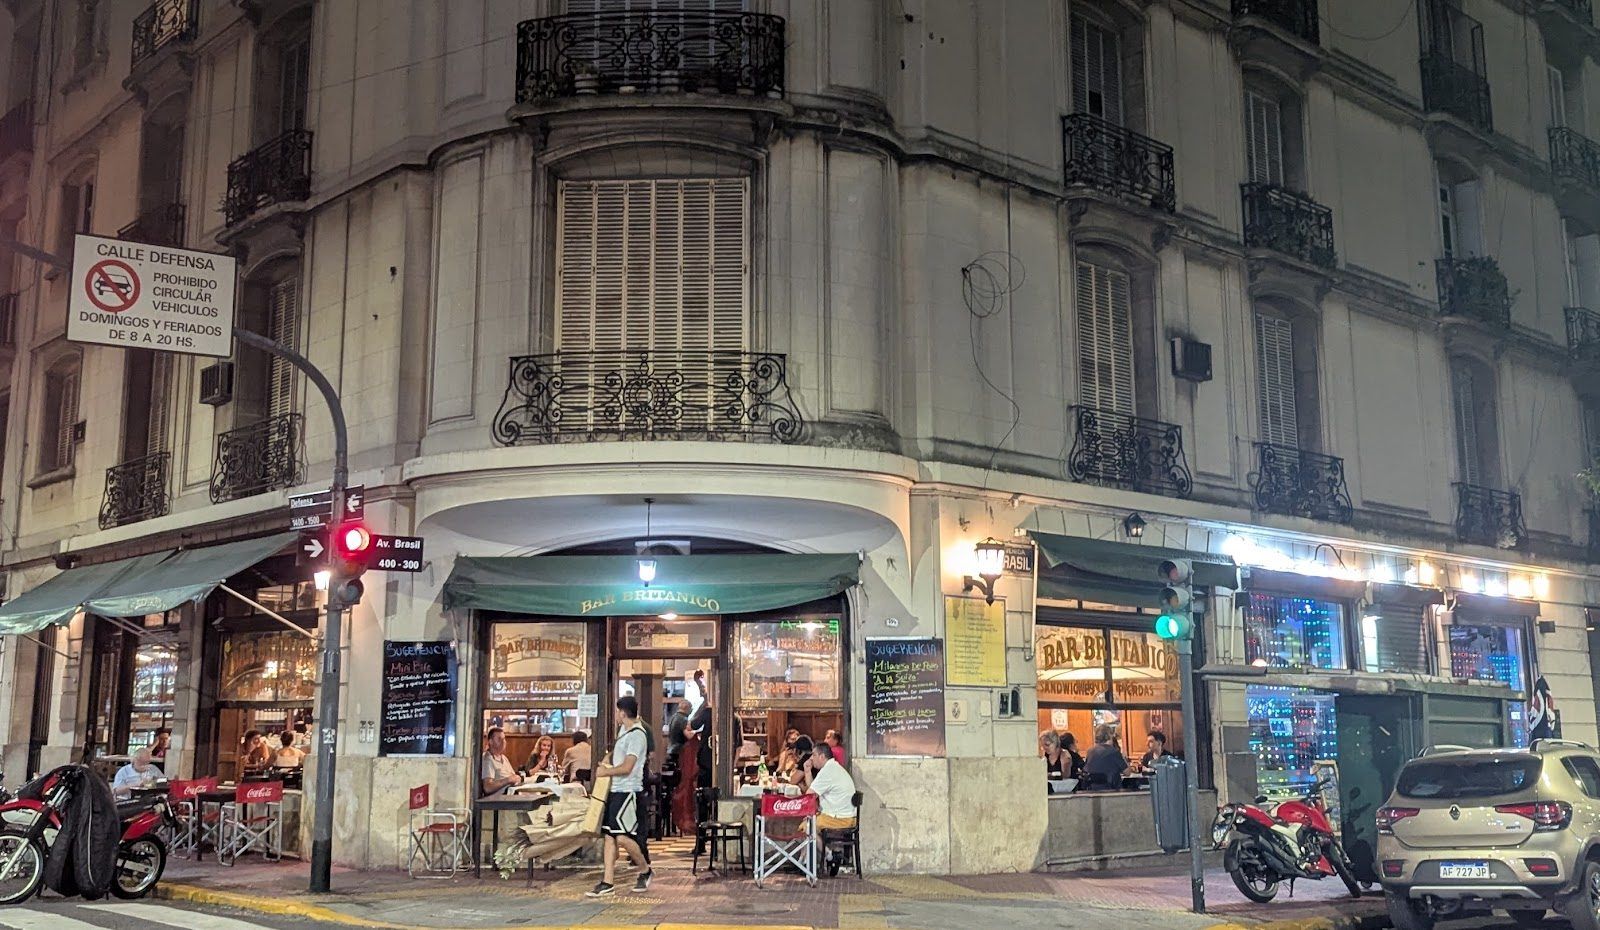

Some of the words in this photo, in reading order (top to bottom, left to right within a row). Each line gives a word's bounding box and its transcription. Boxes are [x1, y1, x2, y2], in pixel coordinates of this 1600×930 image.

[97, 243, 145, 261] CALLE
[150, 251, 215, 271] DEFENSA
[153, 272, 218, 290] PROHIBIDO
[152, 287, 212, 303] CIRCULAR
[152, 300, 219, 318] VEHICULOS
[79, 311, 150, 328] DOMINGOS
[152, 319, 162, 329] Y
[163, 321, 222, 337] FERIADOS
[109, 329, 126, 340] DE
[129, 331, 138, 342] 8
[142, 332, 152, 343] A
[156, 334, 172, 345] 20
[176, 336, 196, 348] HS.
[290, 498, 313, 509] Defensa
[376, 539, 390, 548] Av.
[394, 539, 421, 549] Brasil
[1003, 555, 1032, 571] RASIL
[581, 595, 615, 614] BAR
[622, 589, 720, 613] BRITANICO
[1043, 635, 1081, 671] BAR
[1084, 635, 1178, 676] BRITANICO
[1442, 867, 1453, 877] AF
[1456, 867, 1473, 877] 727
[1475, 867, 1487, 877] JP
